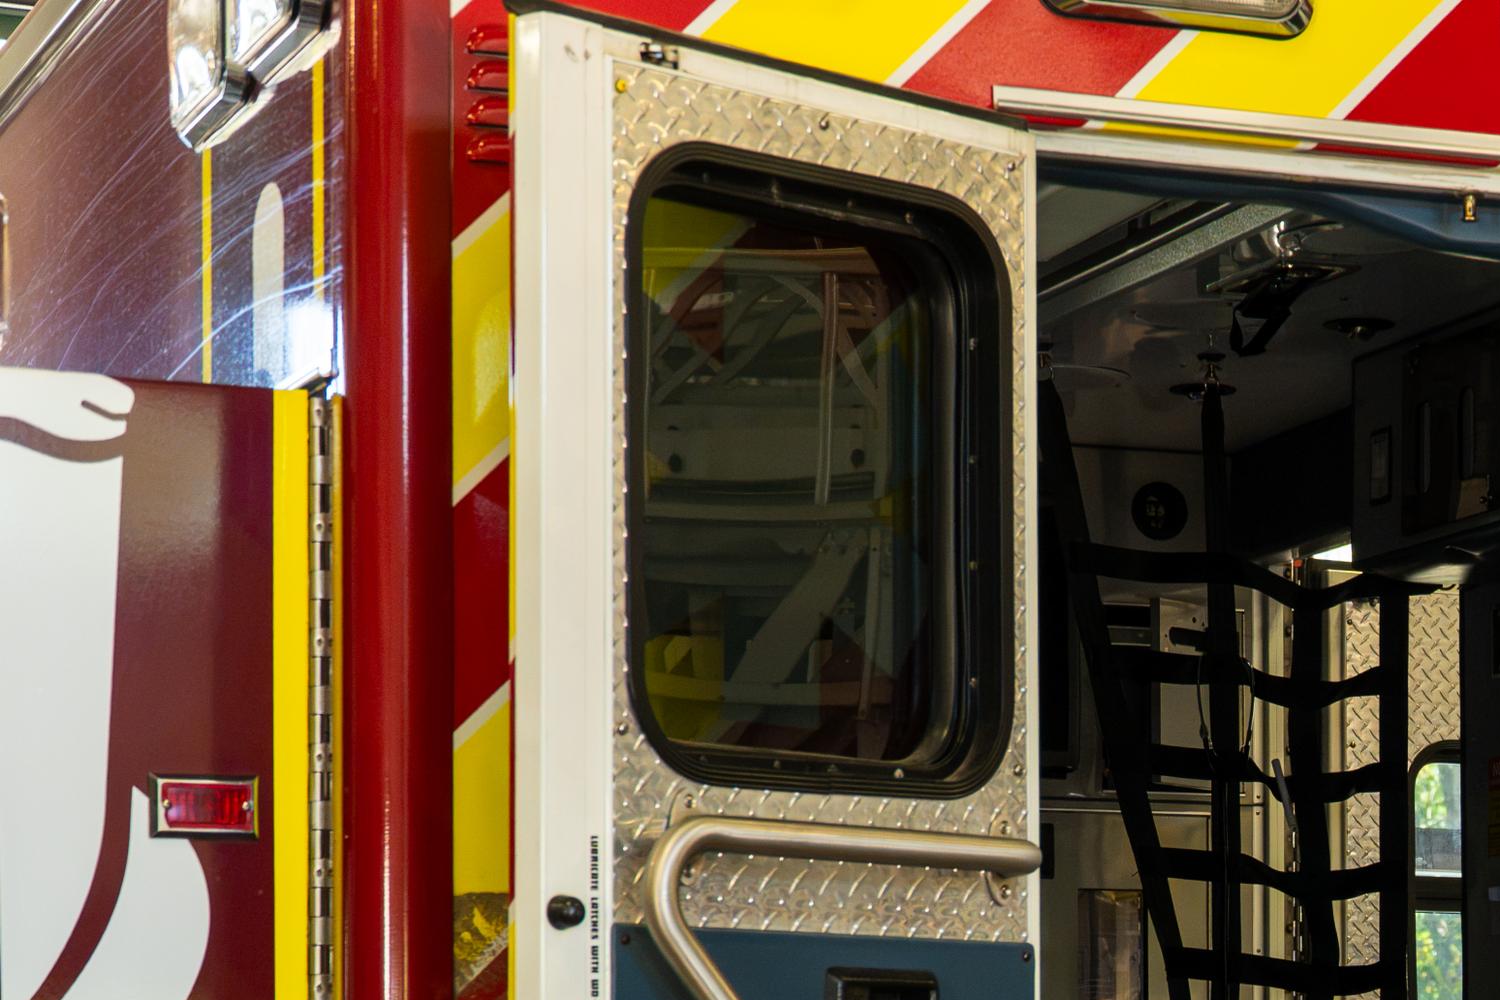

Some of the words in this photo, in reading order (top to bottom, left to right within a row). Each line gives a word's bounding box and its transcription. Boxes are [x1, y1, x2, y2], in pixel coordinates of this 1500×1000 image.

[590, 835, 599, 891] LUBRICATE
[590, 897, 599, 940] LATCHES
[591, 945, 599, 974] WITH
